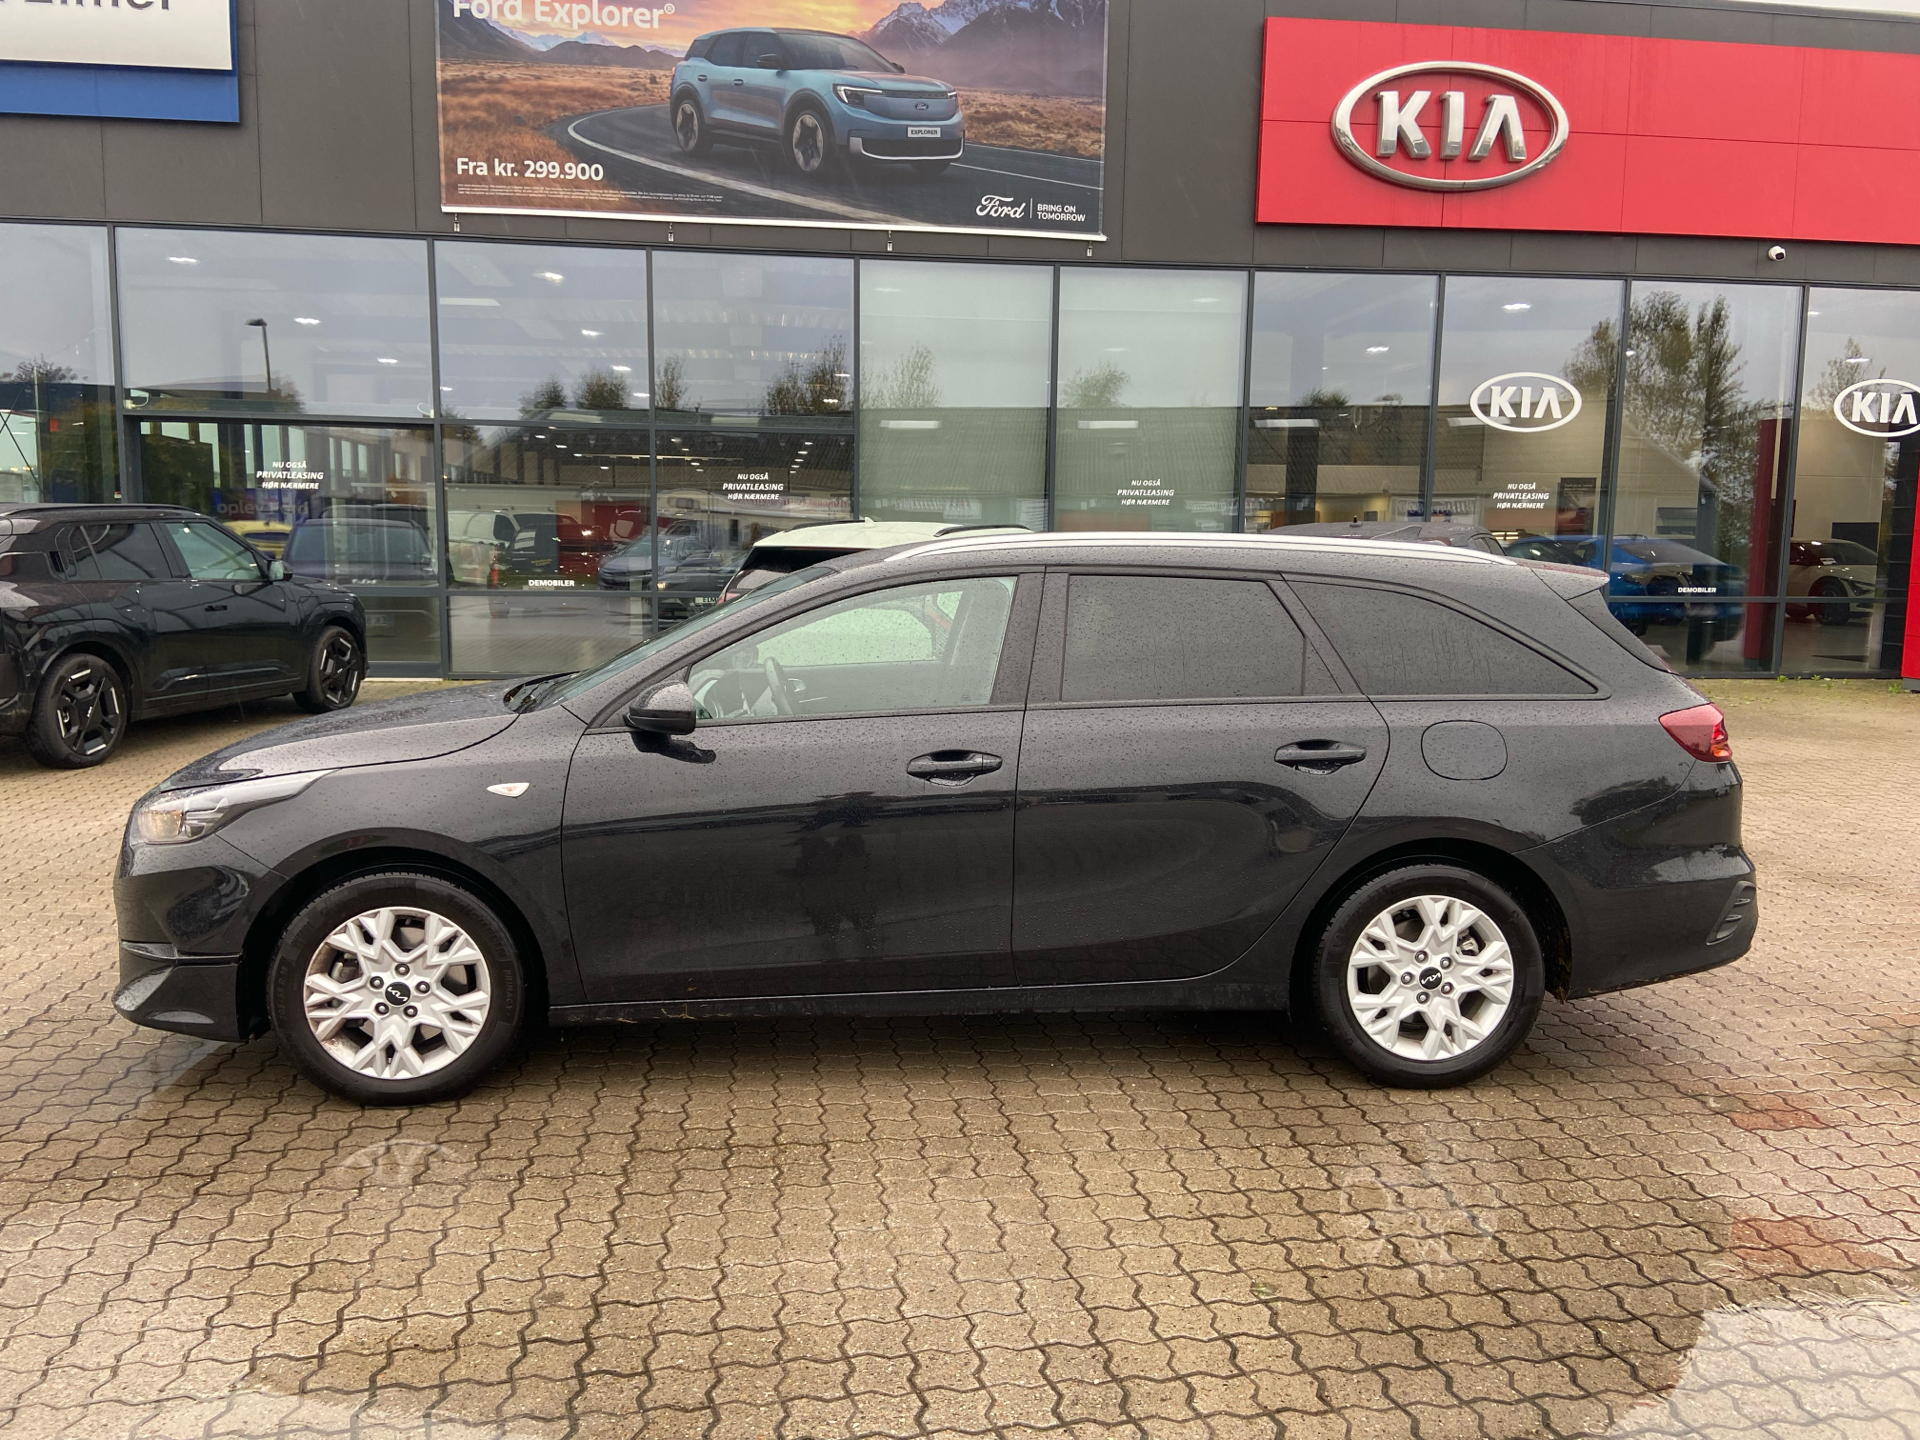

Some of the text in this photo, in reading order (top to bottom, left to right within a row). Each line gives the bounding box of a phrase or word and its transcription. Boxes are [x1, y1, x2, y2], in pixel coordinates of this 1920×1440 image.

[1374, 90, 1528, 162] KIA
[456, 157, 604, 181] Fra kr. 299.900
[975, 194, 1027, 219] Ford
[1037, 203, 1077, 214] BRING ON
[1036, 211, 1086, 222] TOMORROW
[1489, 386, 1563, 419] KIA
[1851, 391, 1918, 424] KIA
[272, 460, 307, 469] NU OGSÅ
[256, 470, 324, 480] PRIVATLEASING
[749, 472, 769, 480] OGSÅ
[261, 481, 320, 490] HØR NÆRMERE
[722, 483, 784, 491] PRIVATLEASING
[1131, 478, 1161, 487] NU OGSÅ
[1518, 482, 1537, 490] OGSÅ
[1492, 492, 1550, 500] PRIVATLEASING
[528, 579, 575, 587] DEMOBILER
